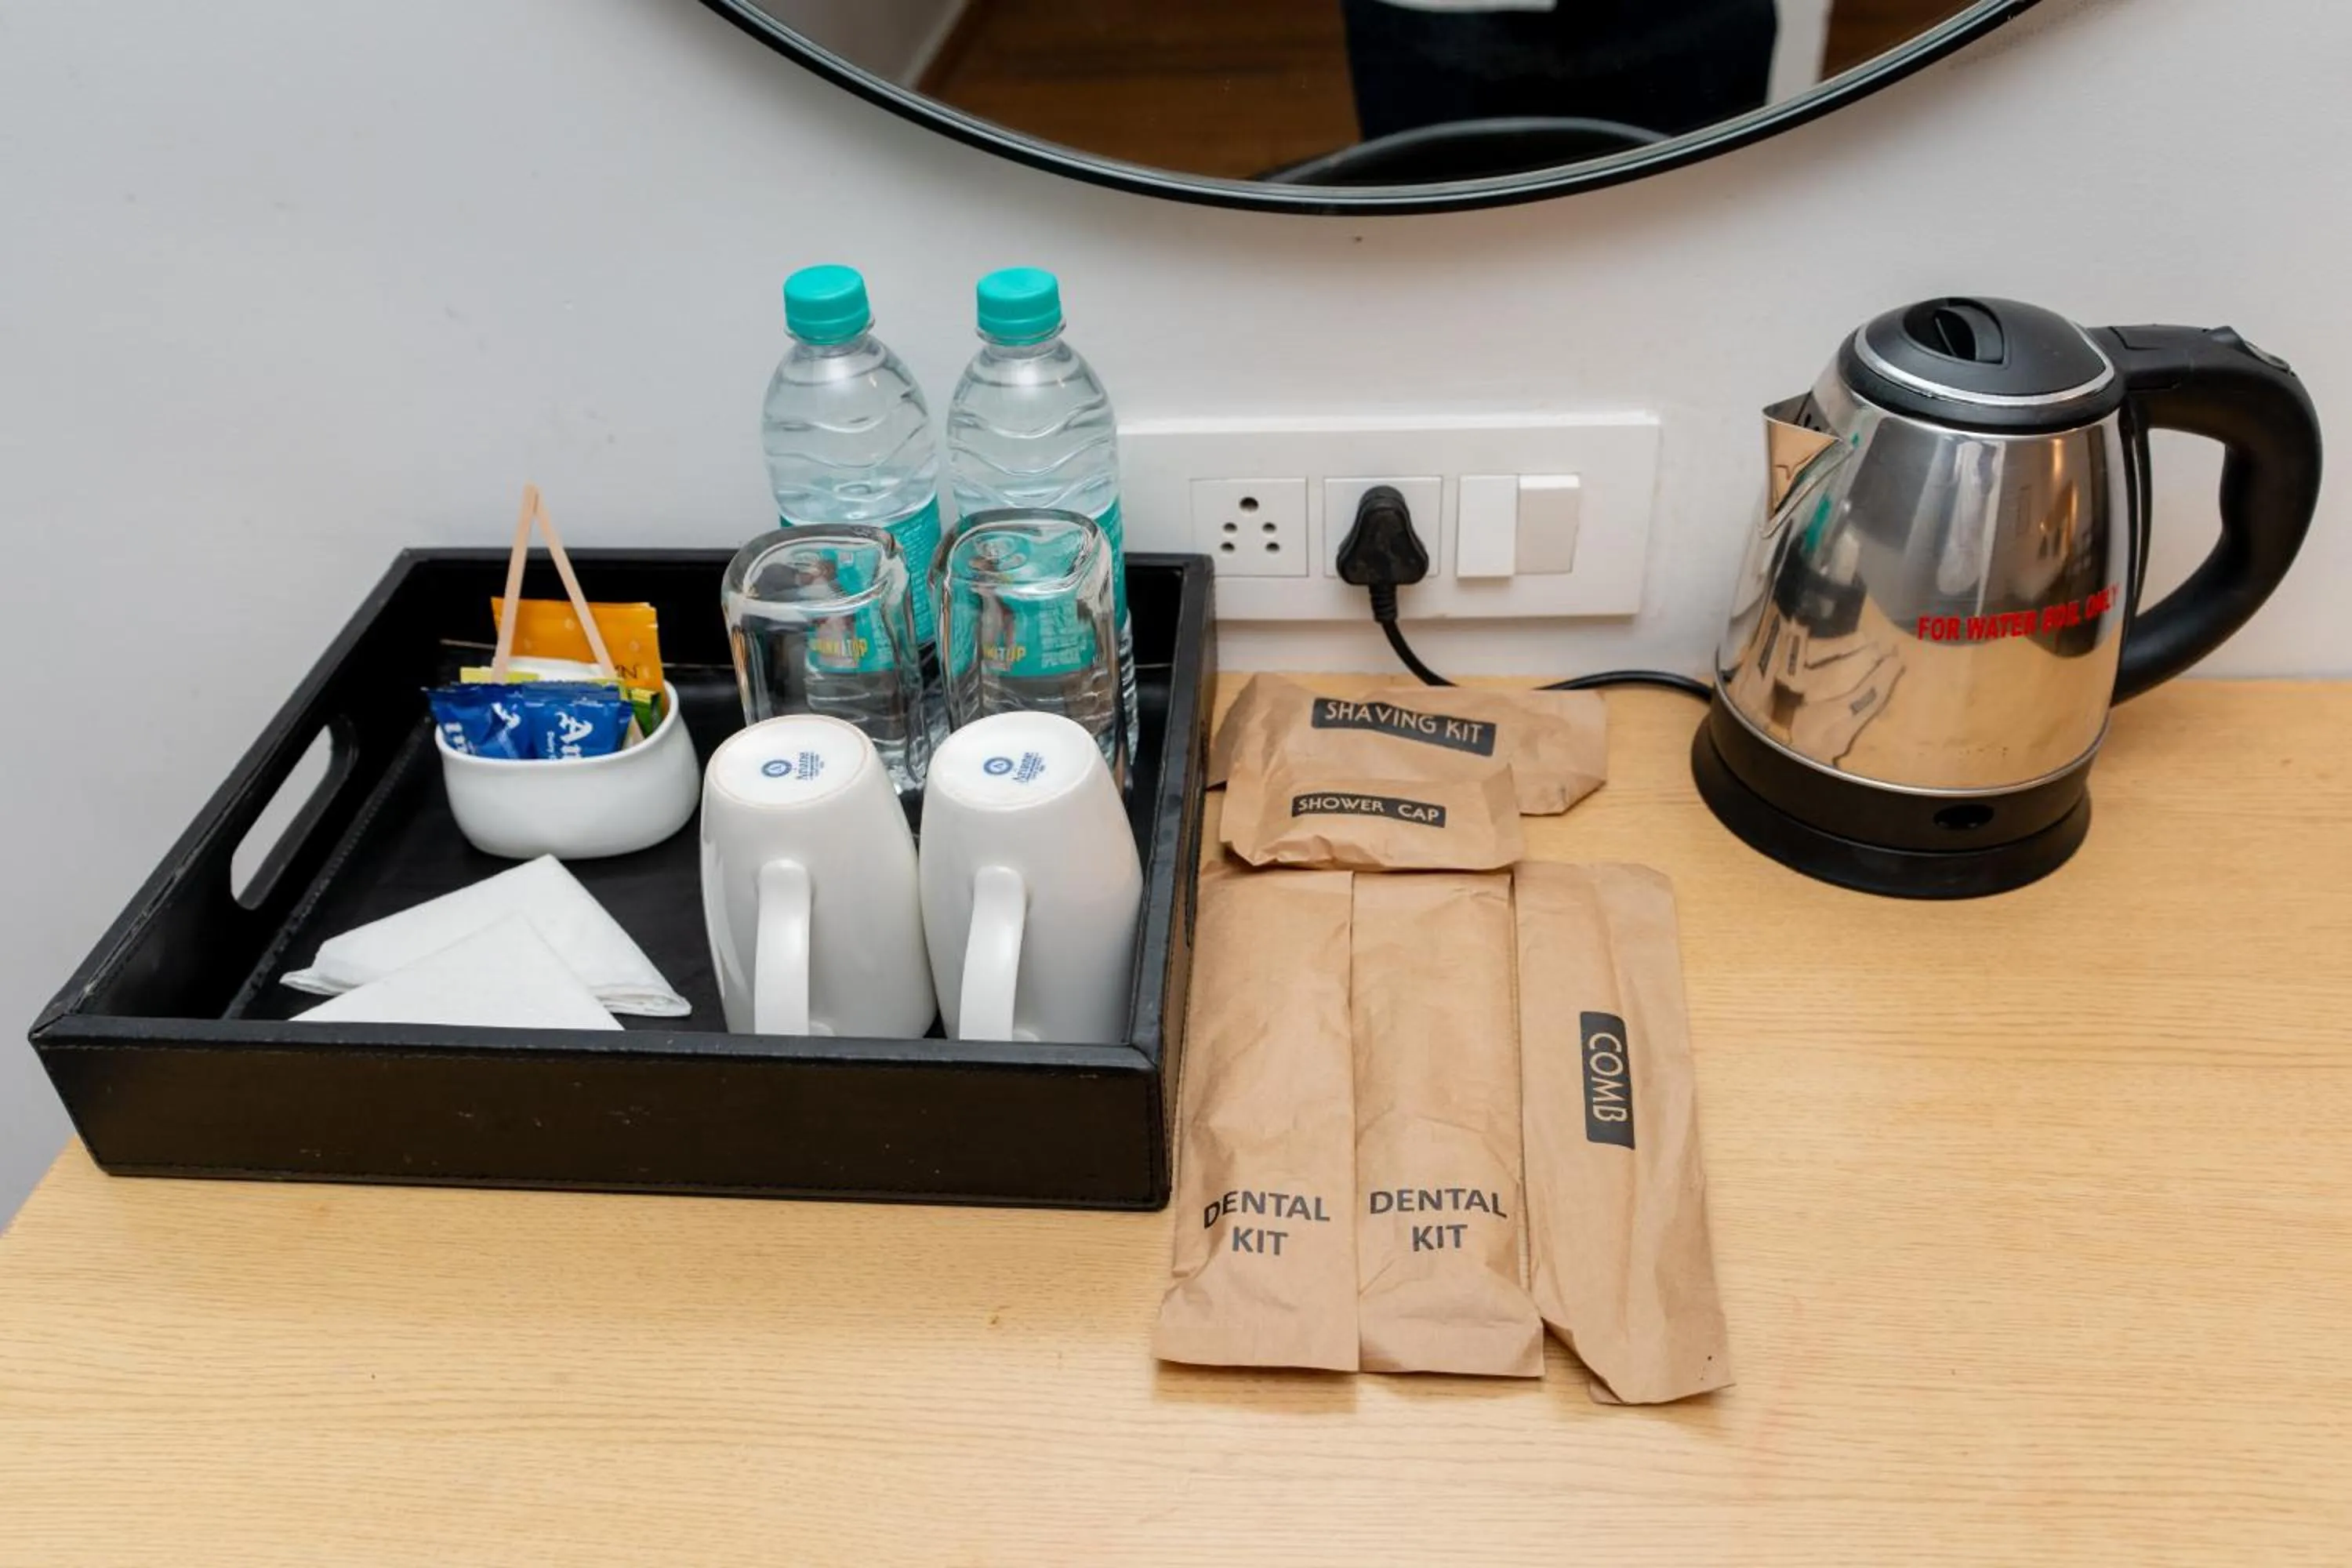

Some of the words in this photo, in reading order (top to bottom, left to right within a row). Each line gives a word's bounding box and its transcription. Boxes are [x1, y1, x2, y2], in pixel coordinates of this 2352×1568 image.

[1917, 617, 1960, 641] FOR
[1966, 611, 2037, 641] WATER
[1325, 702, 1437, 734] SHAVING
[1446, 720, 1483, 745] KIT
[1298, 796, 1385, 813] SHOWER
[1397, 804, 1439, 823] CAP
[1588, 1033, 1628, 1123] COMB
[1203, 1191, 1330, 1229] DENTAL
[1369, 1187, 1508, 1218] DENTAL
[1232, 1225, 1289, 1256] KIT
[1411, 1223, 1468, 1252] KIT
